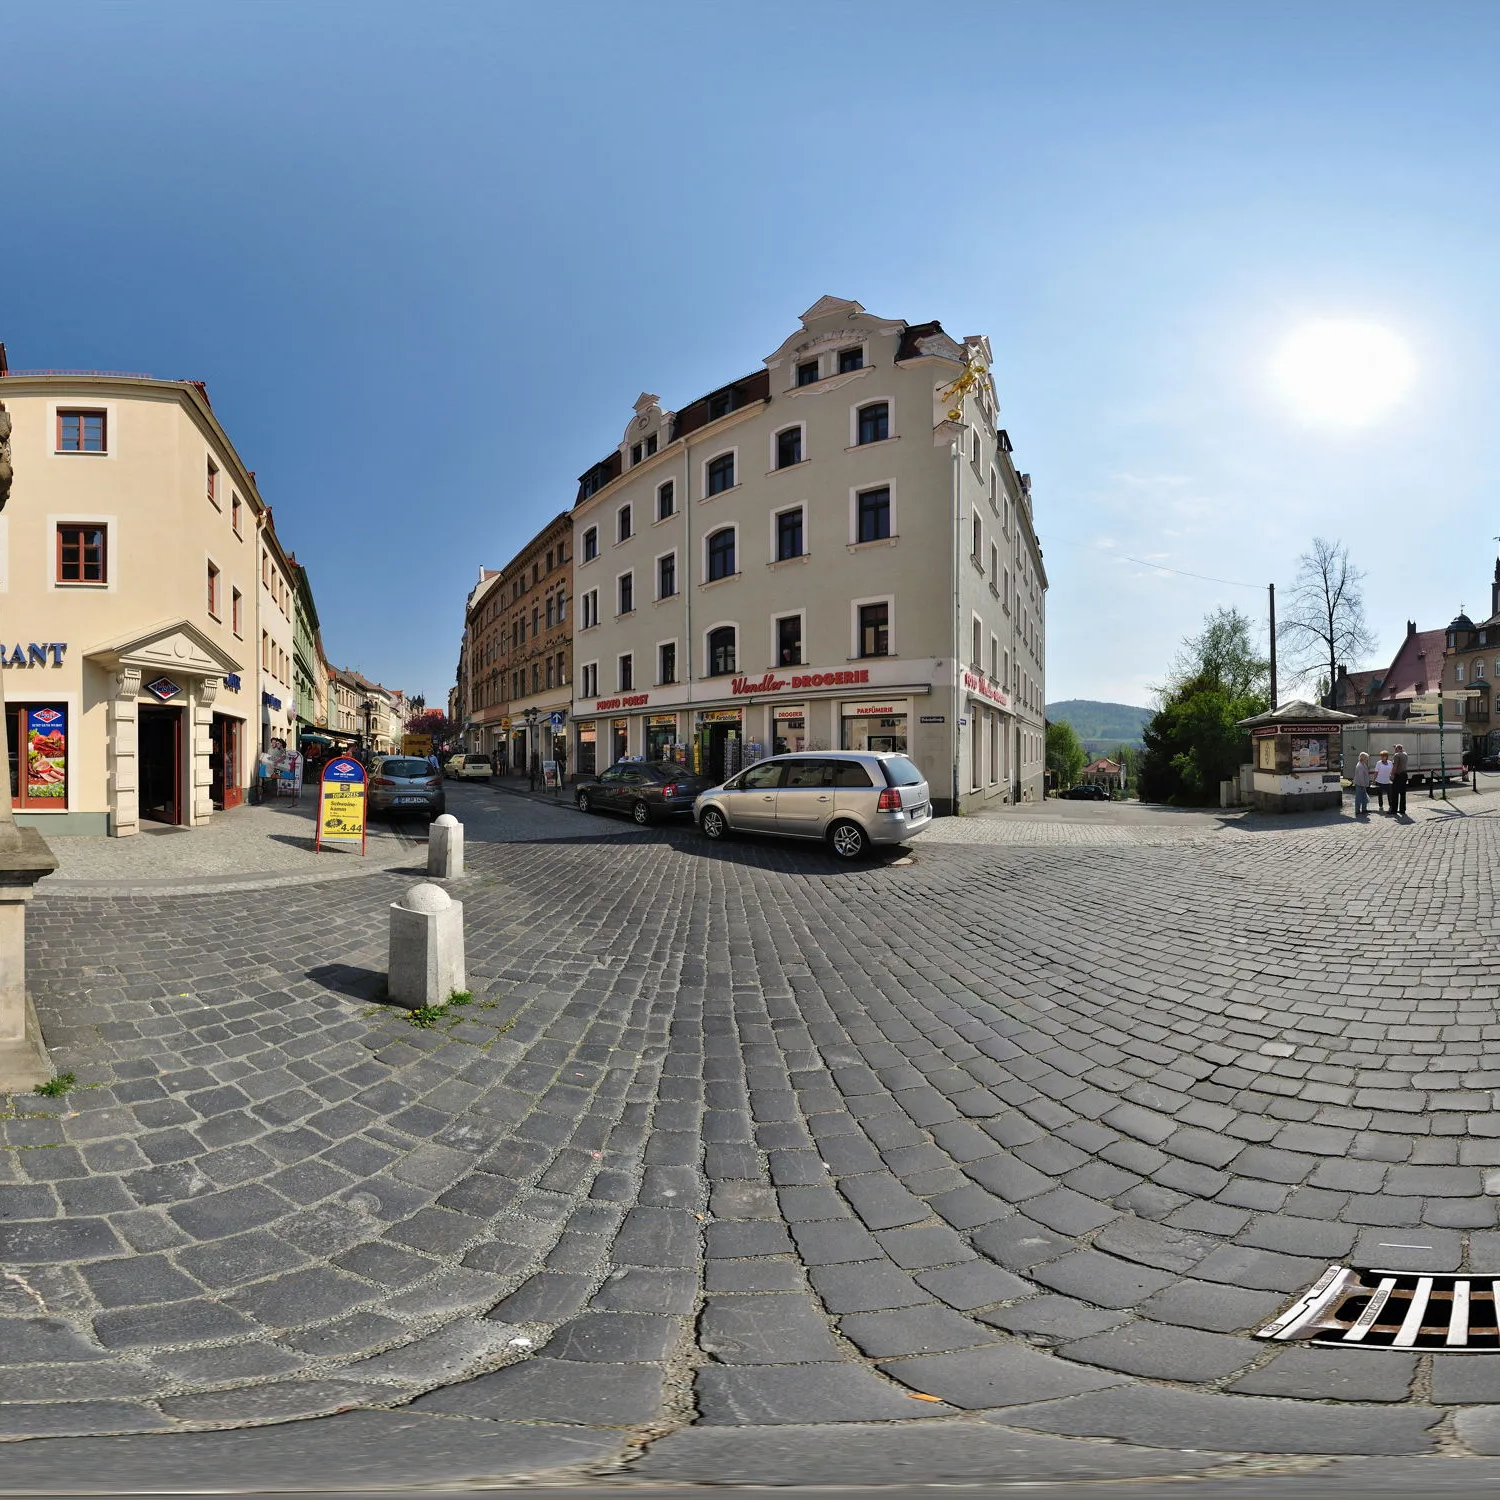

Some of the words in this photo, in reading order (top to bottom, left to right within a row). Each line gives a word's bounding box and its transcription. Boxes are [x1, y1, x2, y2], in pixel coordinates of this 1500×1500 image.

[596, 698, 620, 711] PHOTO
[622, 694, 649, 707] PORST
[856, 705, 893, 714] PARFÜMERIE
[341, 824, 363, 832] 4.44
